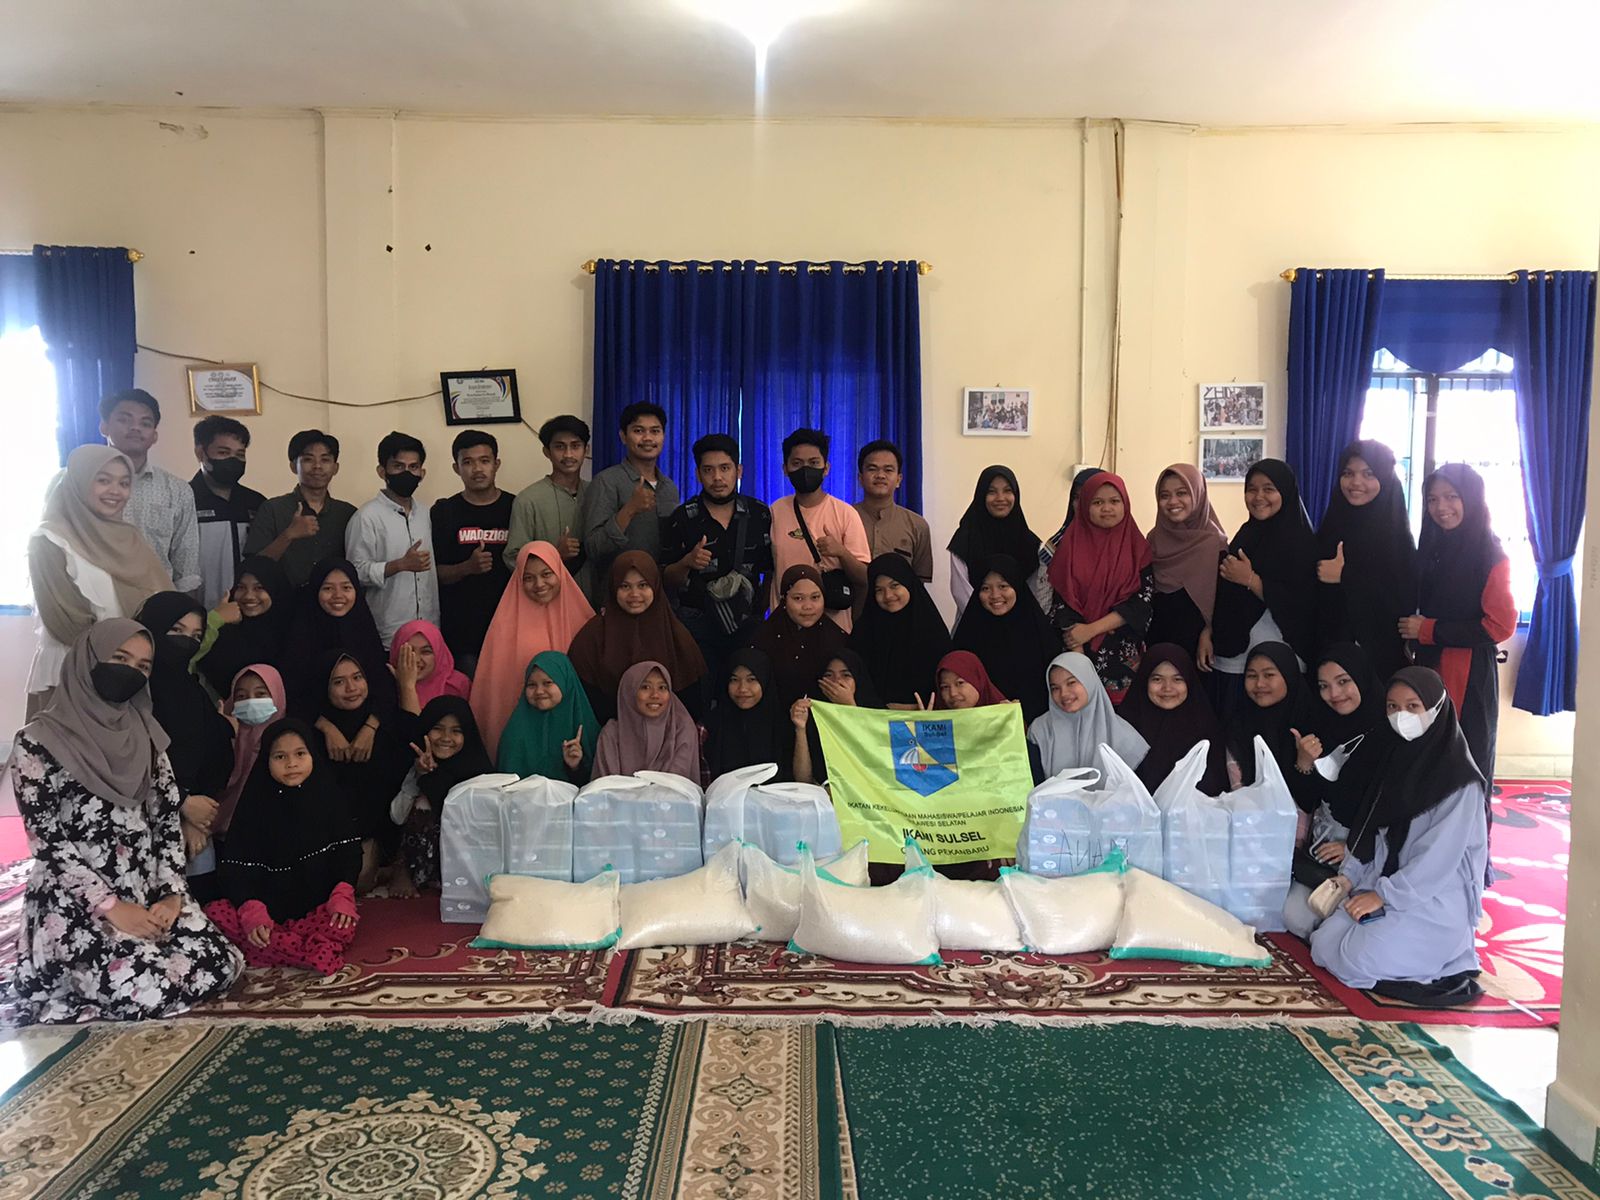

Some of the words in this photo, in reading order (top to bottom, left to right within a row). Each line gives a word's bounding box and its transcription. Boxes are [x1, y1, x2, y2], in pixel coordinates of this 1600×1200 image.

[459, 529, 509, 542] WADEZIG!
[922, 723, 947, 732] IKAMI
[847, 801, 872, 810] IKATAN
[988, 805, 1025, 815] INDONESIA
[938, 819, 967, 828] SELATAN
[902, 828, 935, 843] IKAMI
[936, 831, 987, 844] SULSEL
[937, 845, 989, 856] PEKANBARU
